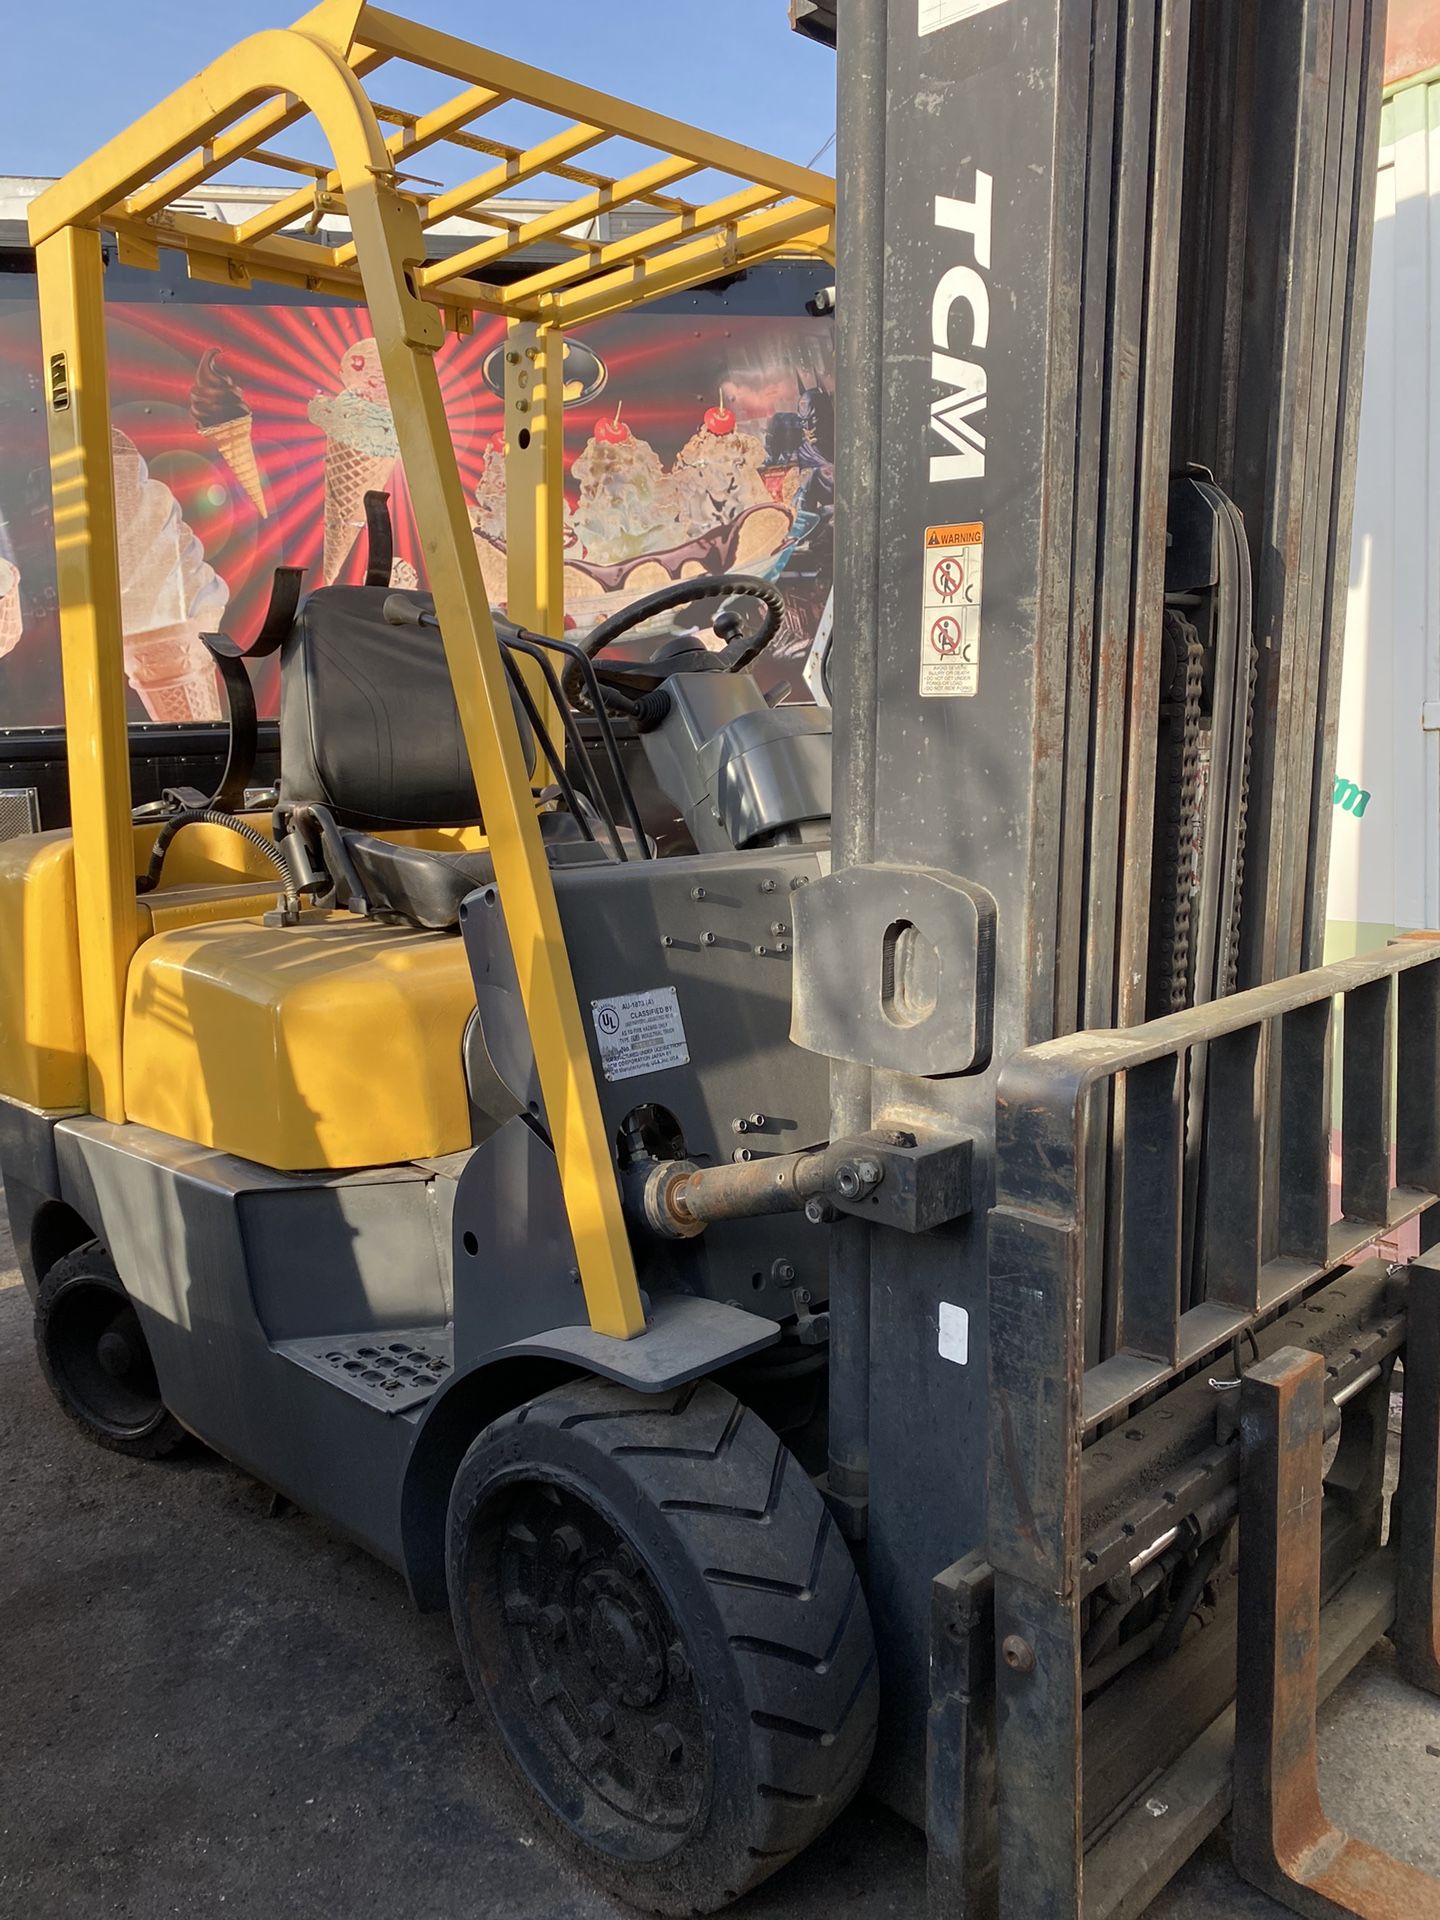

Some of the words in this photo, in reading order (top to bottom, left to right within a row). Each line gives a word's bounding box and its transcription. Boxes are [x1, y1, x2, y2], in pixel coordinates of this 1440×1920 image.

[929, 168, 993, 483] TCM
[940, 531, 981, 545] WARNING
[631, 1007, 664, 1019] CLASSIFIED
[602, 1013, 616, 1029] UL
